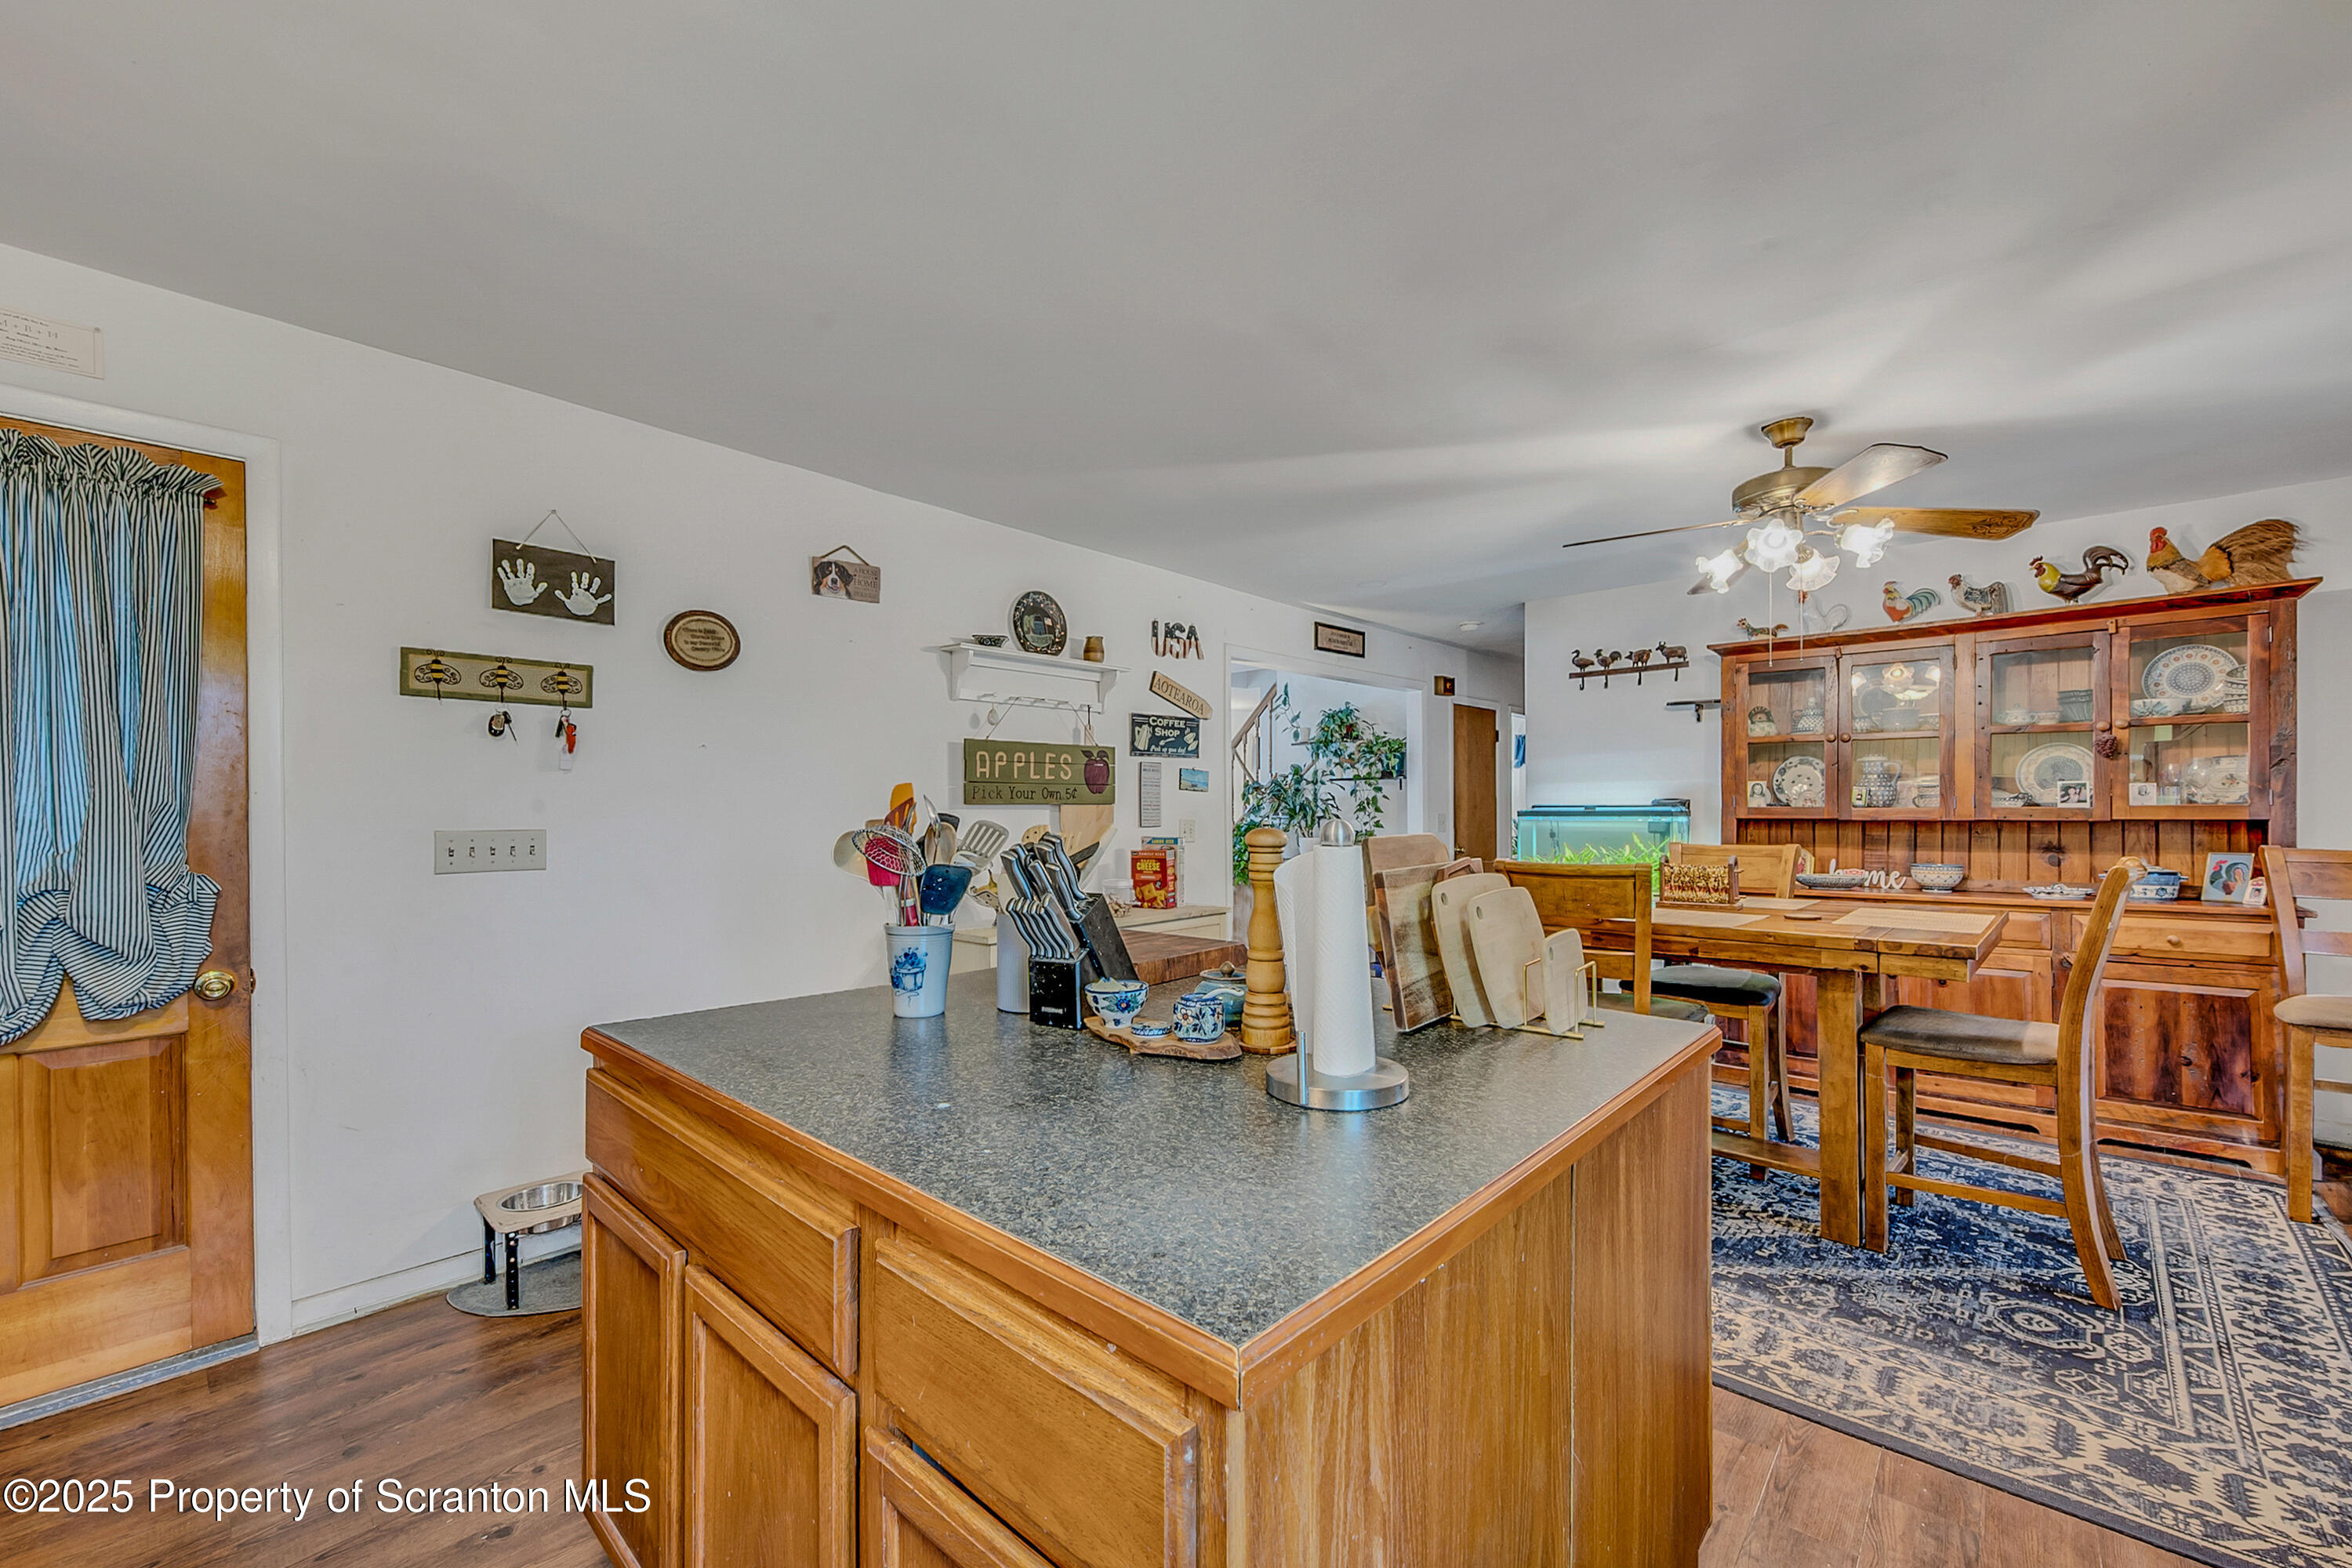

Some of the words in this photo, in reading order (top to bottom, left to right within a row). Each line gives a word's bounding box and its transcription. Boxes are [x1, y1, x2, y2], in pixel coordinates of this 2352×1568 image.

[853, 577, 878, 589] HOME
[1151, 619, 1204, 660] USA
[1154, 677, 1204, 716] AOTEAROA
[1149, 716, 1186, 728] COFFEE
[1154, 727, 1181, 737] SHOP
[975, 750, 1073, 781] APPLES
[972, 786, 1003, 800] Pick
[1008, 786, 1036, 800] Your
[1065, 786, 1077, 800] 5¢
[1136, 862, 1161, 871] CHEESE
[1828, 858, 1907, 890] hme
